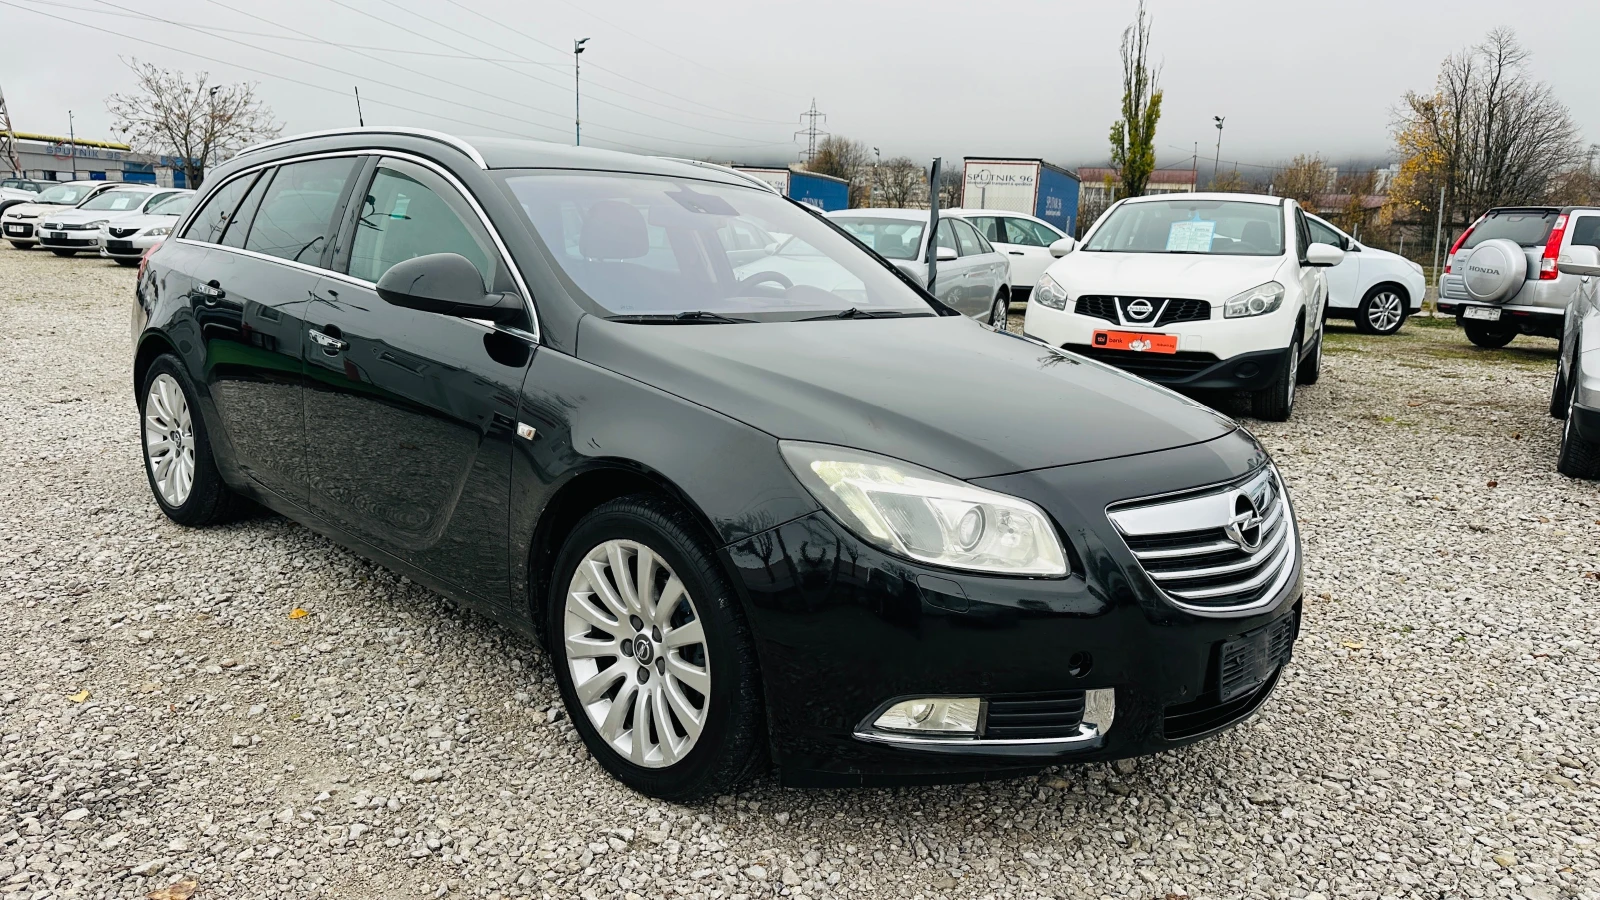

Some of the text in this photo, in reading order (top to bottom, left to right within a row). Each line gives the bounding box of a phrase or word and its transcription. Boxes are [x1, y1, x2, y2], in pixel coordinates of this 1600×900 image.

[45, 146, 99, 158] SPUTNIK
[967, 173, 1033, 183] SPUTNIK 96
[1469, 265, 1500, 275] HONDA
